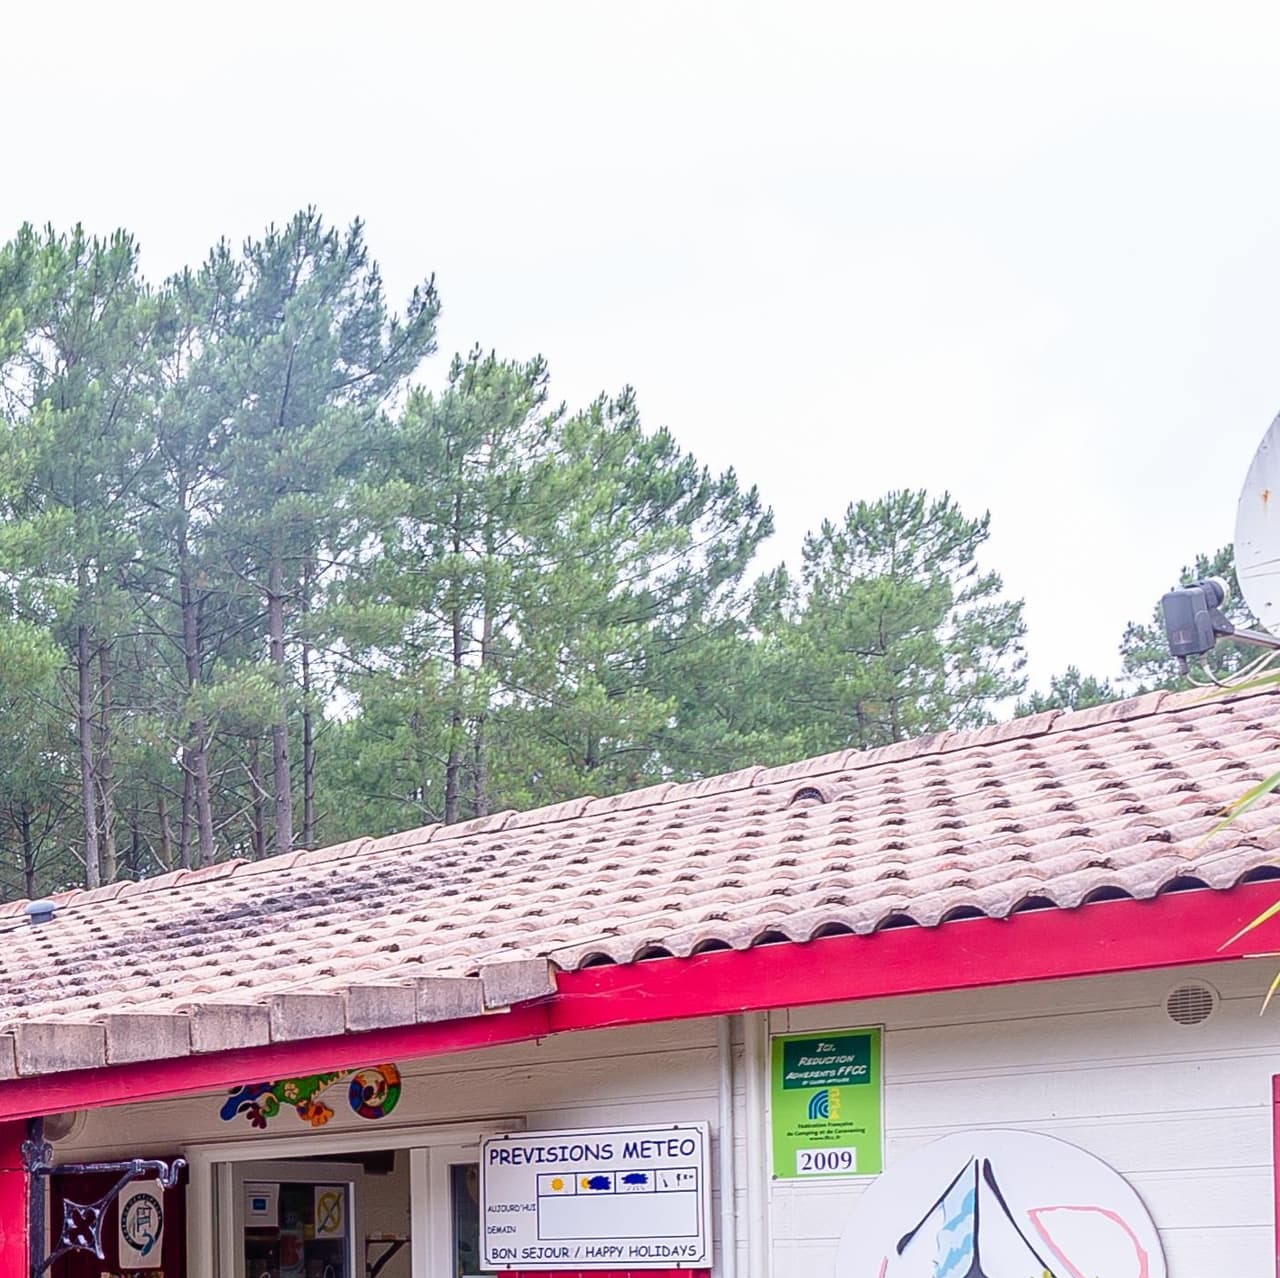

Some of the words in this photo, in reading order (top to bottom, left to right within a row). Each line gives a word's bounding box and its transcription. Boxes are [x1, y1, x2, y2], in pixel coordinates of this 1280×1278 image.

[489, 1144, 614, 1165] PREVISIONS
[622, 1139, 696, 1159] METEO
[801, 1151, 853, 1171] 2009
[487, 1203, 537, 1213] AUJOURD'HUI
[487, 1226, 517, 1235] DEMAIN
[491, 1247, 517, 1260] BON
[521, 1246, 570, 1259] SEJOUR
[585, 1245, 623, 1258] HAPPY
[628, 1244, 697, 1257] HOLIDAYS
